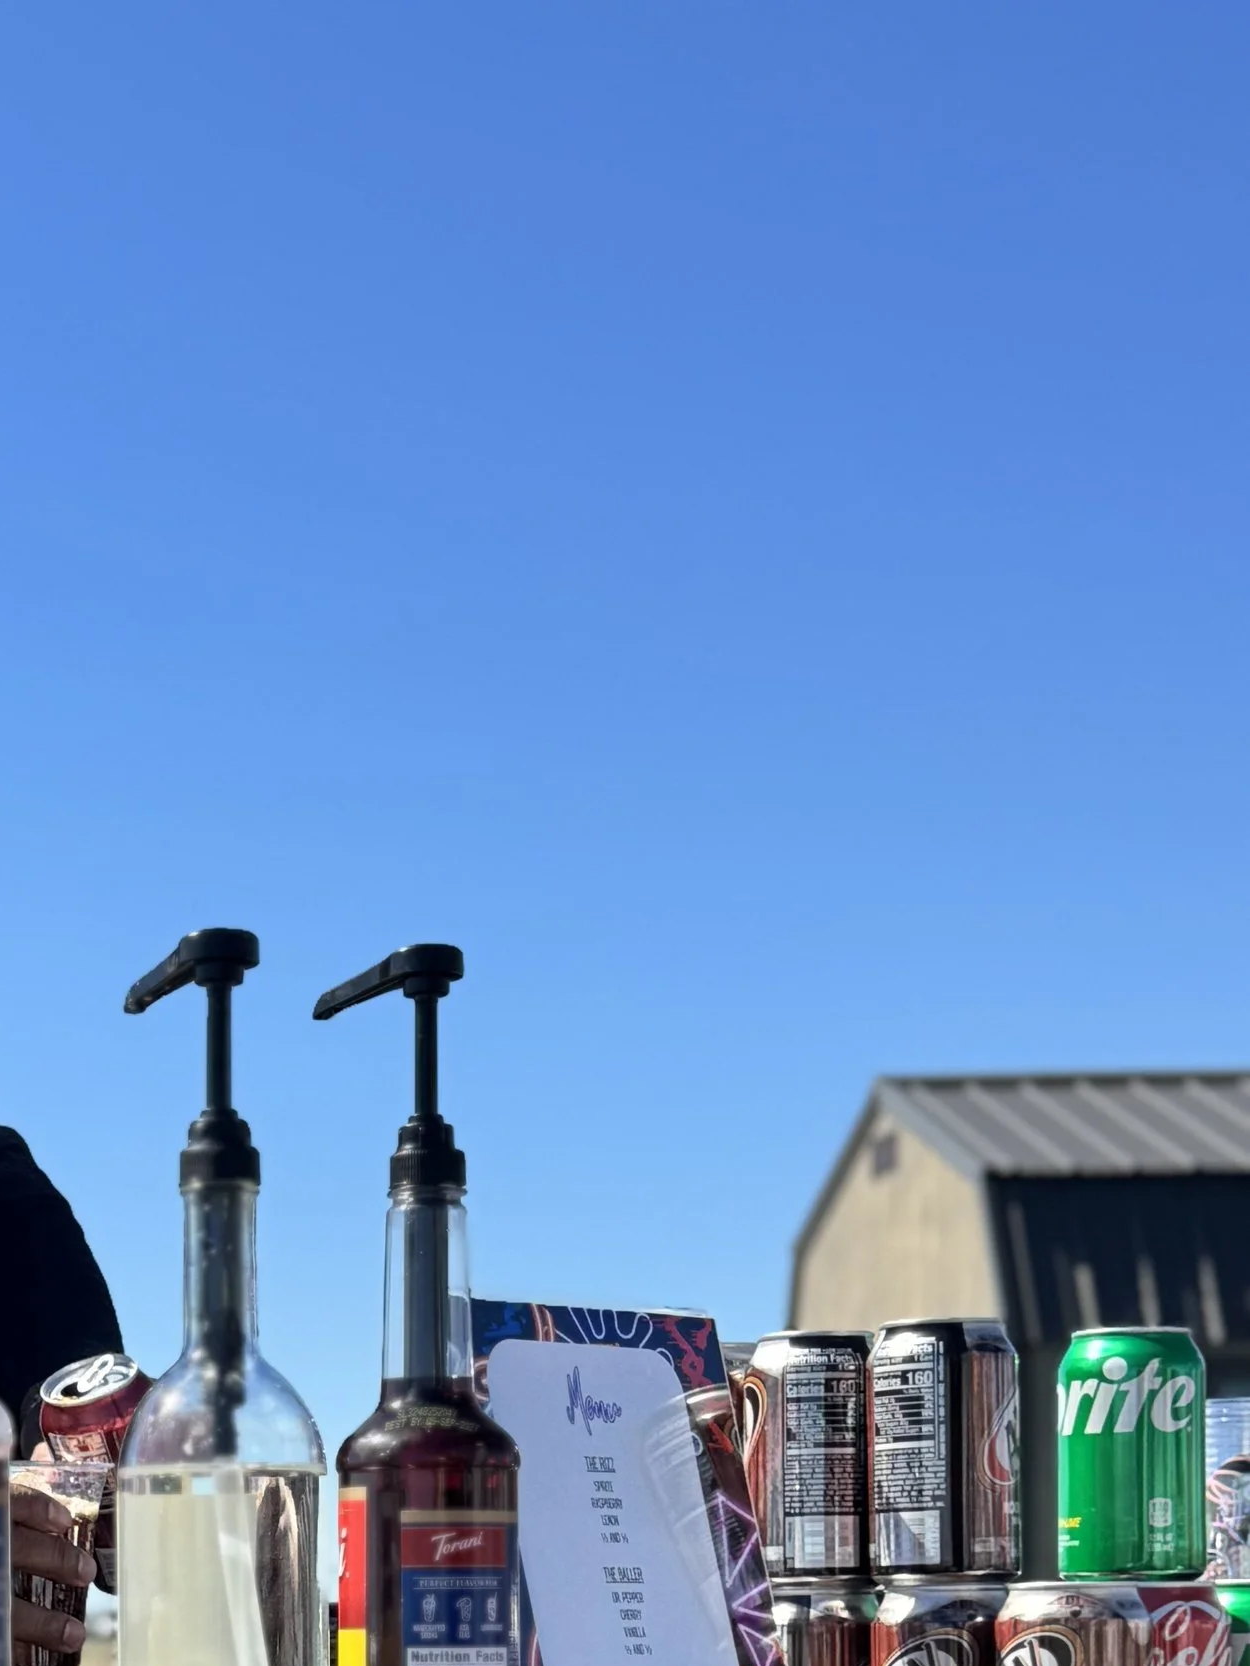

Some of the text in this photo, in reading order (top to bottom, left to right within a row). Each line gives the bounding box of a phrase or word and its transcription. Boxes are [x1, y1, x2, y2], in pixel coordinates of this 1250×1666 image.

[906, 1370, 933, 1385] 160
[1057, 1356, 1196, 1436] rite
[584, 1456, 598, 1470] THE
[601, 1515, 619, 1526] LEMON
[609, 1533, 621, 1544] AND
[431, 1532, 483, 1561] Torani
[603, 1566, 644, 1582] THE BALLER
[611, 1592, 644, 1603] DR PEPPER
[620, 1609, 642, 1620] CHERRY
[623, 1627, 646, 1638] VANILLA
[411, 1650, 505, 1663] Nutrition Facts
